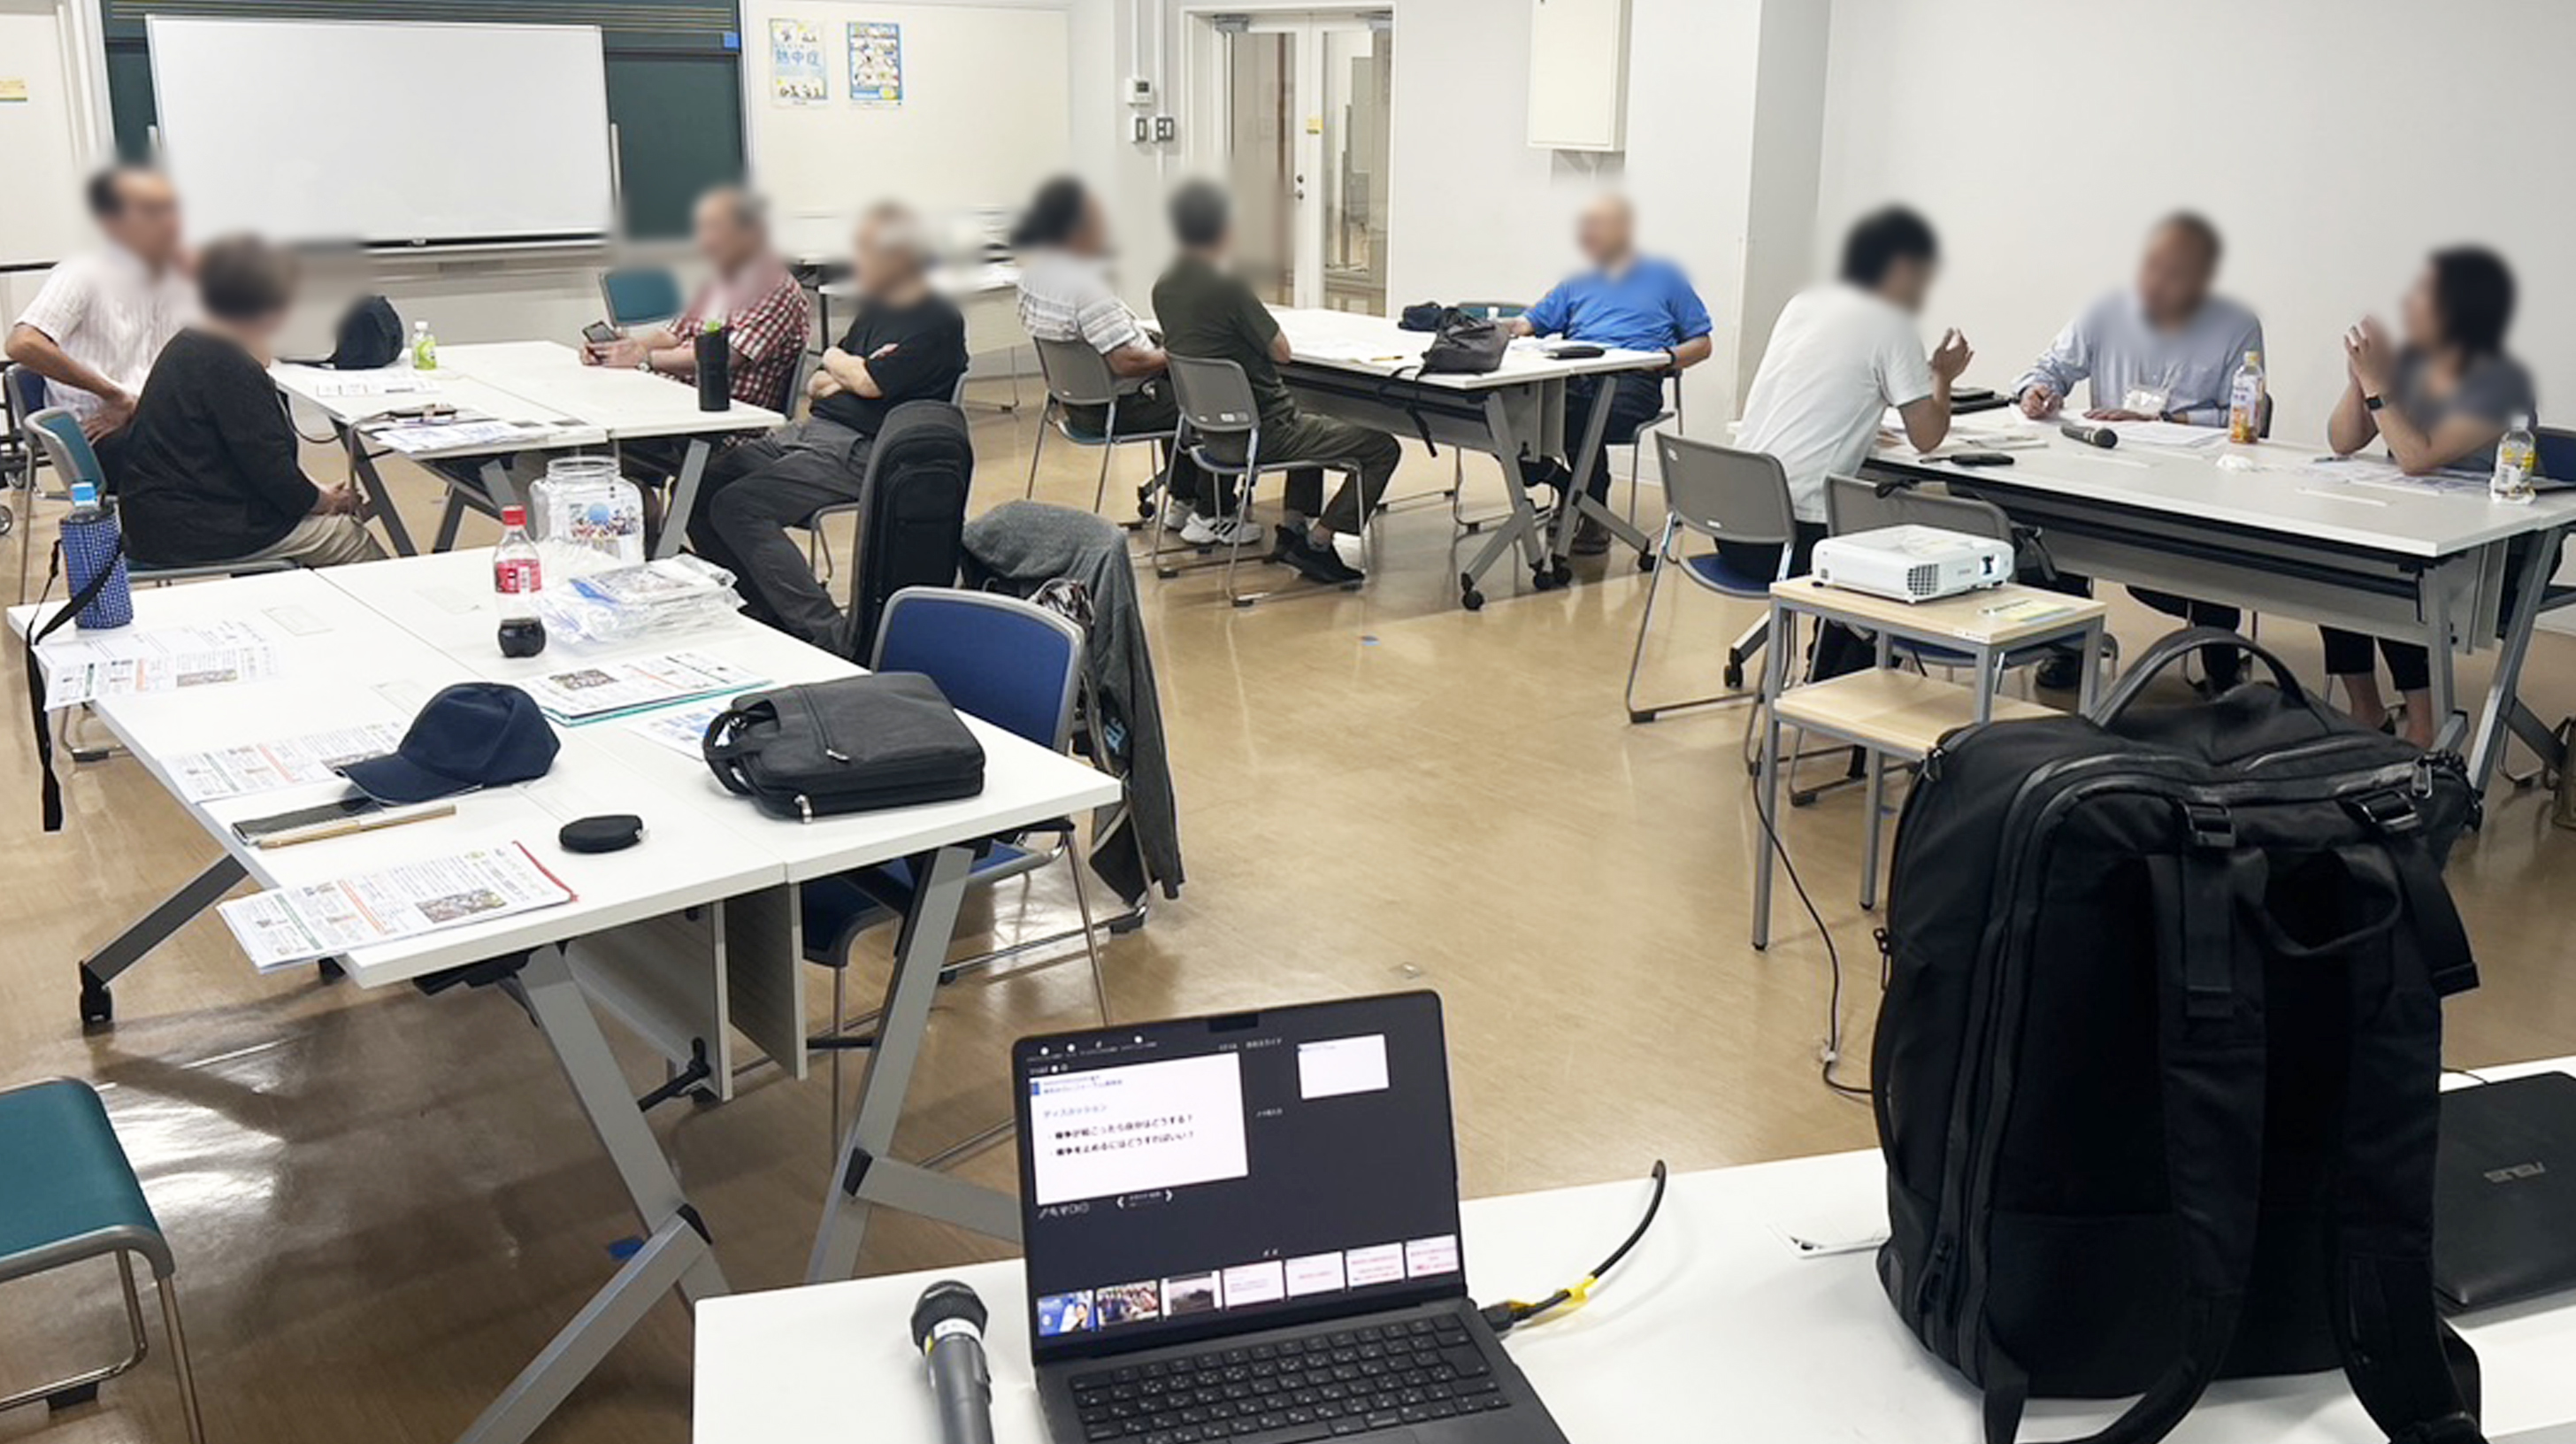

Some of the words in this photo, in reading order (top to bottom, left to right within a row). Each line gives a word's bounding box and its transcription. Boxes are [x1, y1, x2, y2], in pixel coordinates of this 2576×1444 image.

[776, 49, 821, 67] 熱中症
[2483, 1161, 2545, 1183] ASUS
